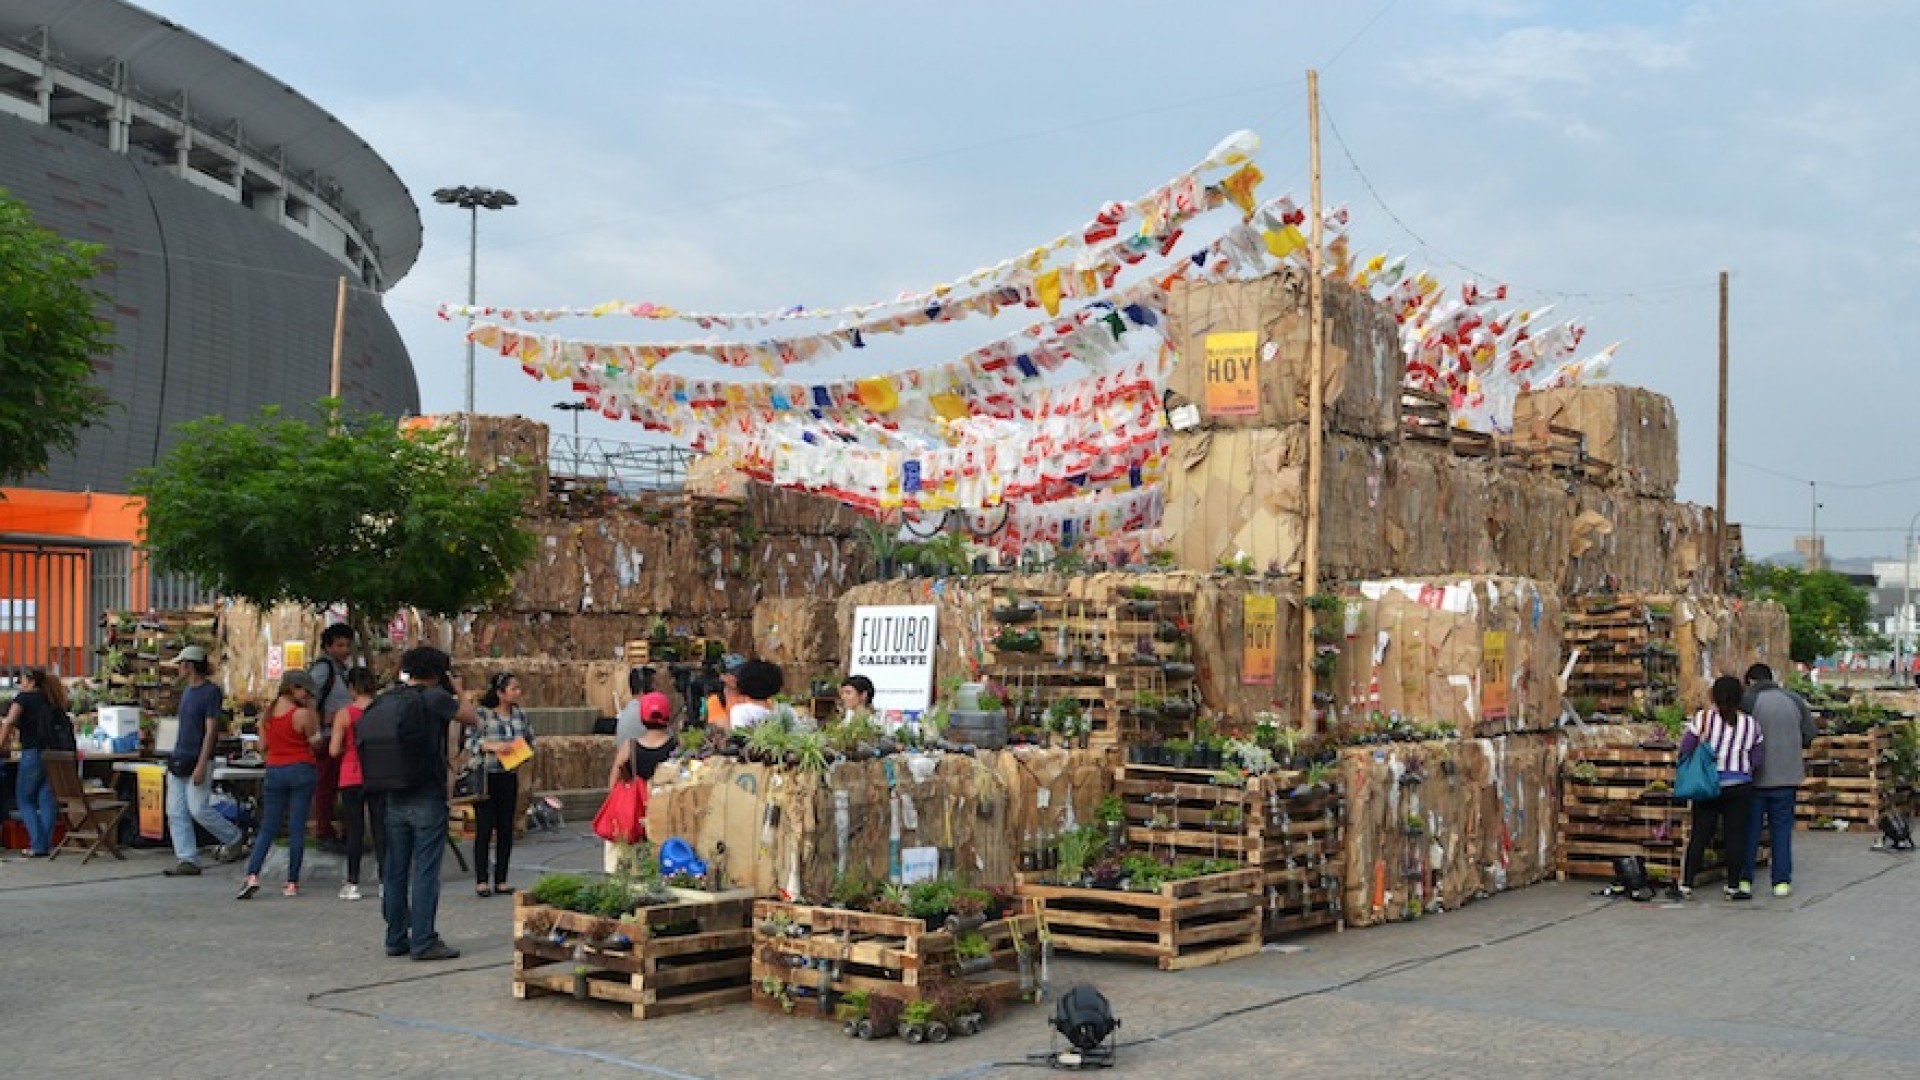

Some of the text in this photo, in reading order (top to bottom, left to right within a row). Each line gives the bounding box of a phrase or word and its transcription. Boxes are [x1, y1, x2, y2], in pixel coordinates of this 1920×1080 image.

[1207, 357, 1252, 382] HOY
[860, 616, 929, 652] FUTURO
[1244, 623, 1273, 650] HOY
[859, 655, 927, 665] CALIENTE
